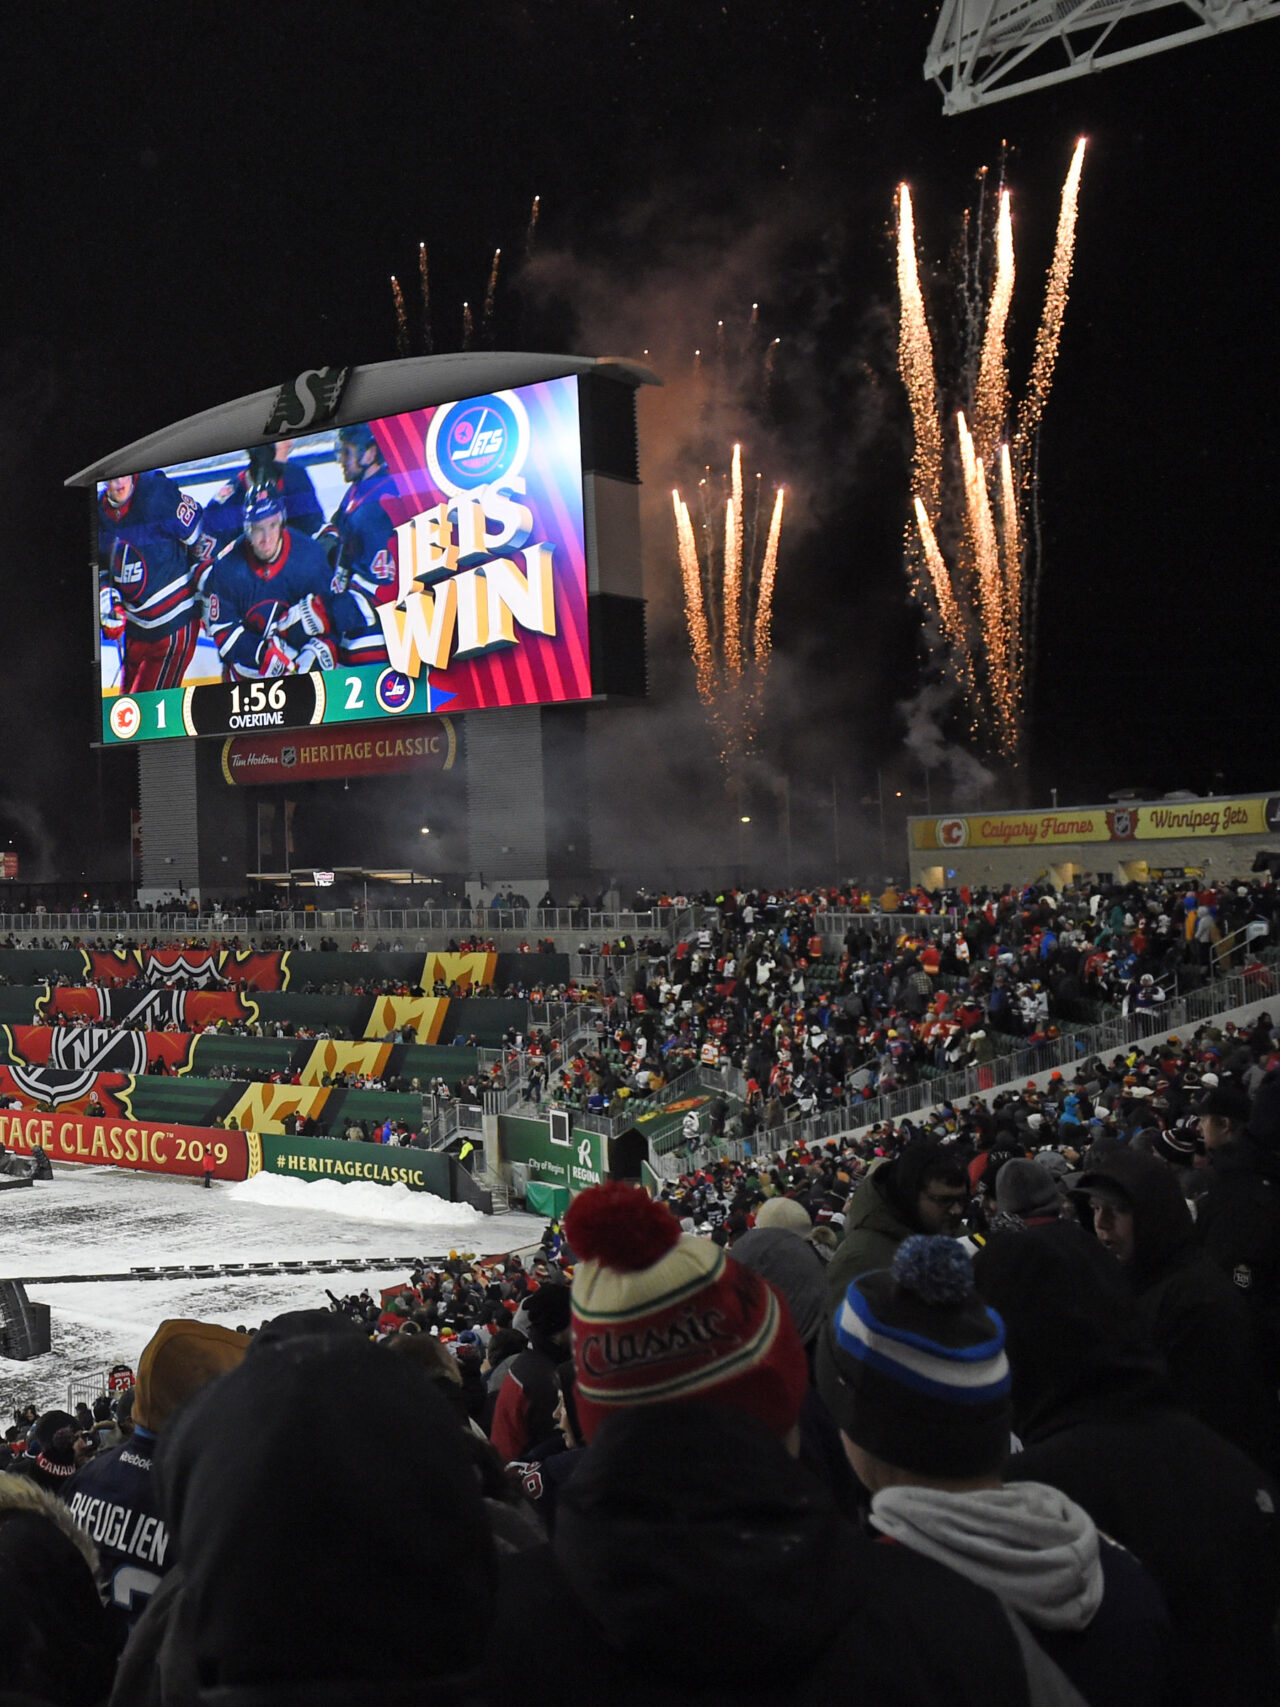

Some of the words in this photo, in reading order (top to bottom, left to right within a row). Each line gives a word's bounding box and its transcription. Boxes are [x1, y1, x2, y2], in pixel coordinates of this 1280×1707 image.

[452, 408, 504, 461] JETS
[393, 476, 534, 606] JETS
[376, 541, 558, 679] WIN
[230, 680, 287, 714] 1:56
[344, 677, 365, 710] 2
[155, 699, 167, 729] 1
[229, 711, 285, 729] OVERTIME
[231, 752, 247, 768] Tim
[247, 752, 278, 766] Hortons
[300, 742, 372, 763] HERITAGE
[375, 737, 440, 757] CLASSIC
[982, 821, 1038, 842] Calgary
[1040, 817, 1094, 839] Flames
[1151, 809, 1219, 833] Winnipeg
[1221, 806, 1249, 829] Jets
[175, 1139, 228, 1164] 209
[529, 1158, 540, 1170] City
[548, 1162, 564, 1175] Regina
[276, 1154, 425, 1186] #HERITAGECLASSIC
[572, 1166, 600, 1184] REGINA
[581, 1304, 726, 1378] Classic
[120, 1450, 152, 1471] Reebok
